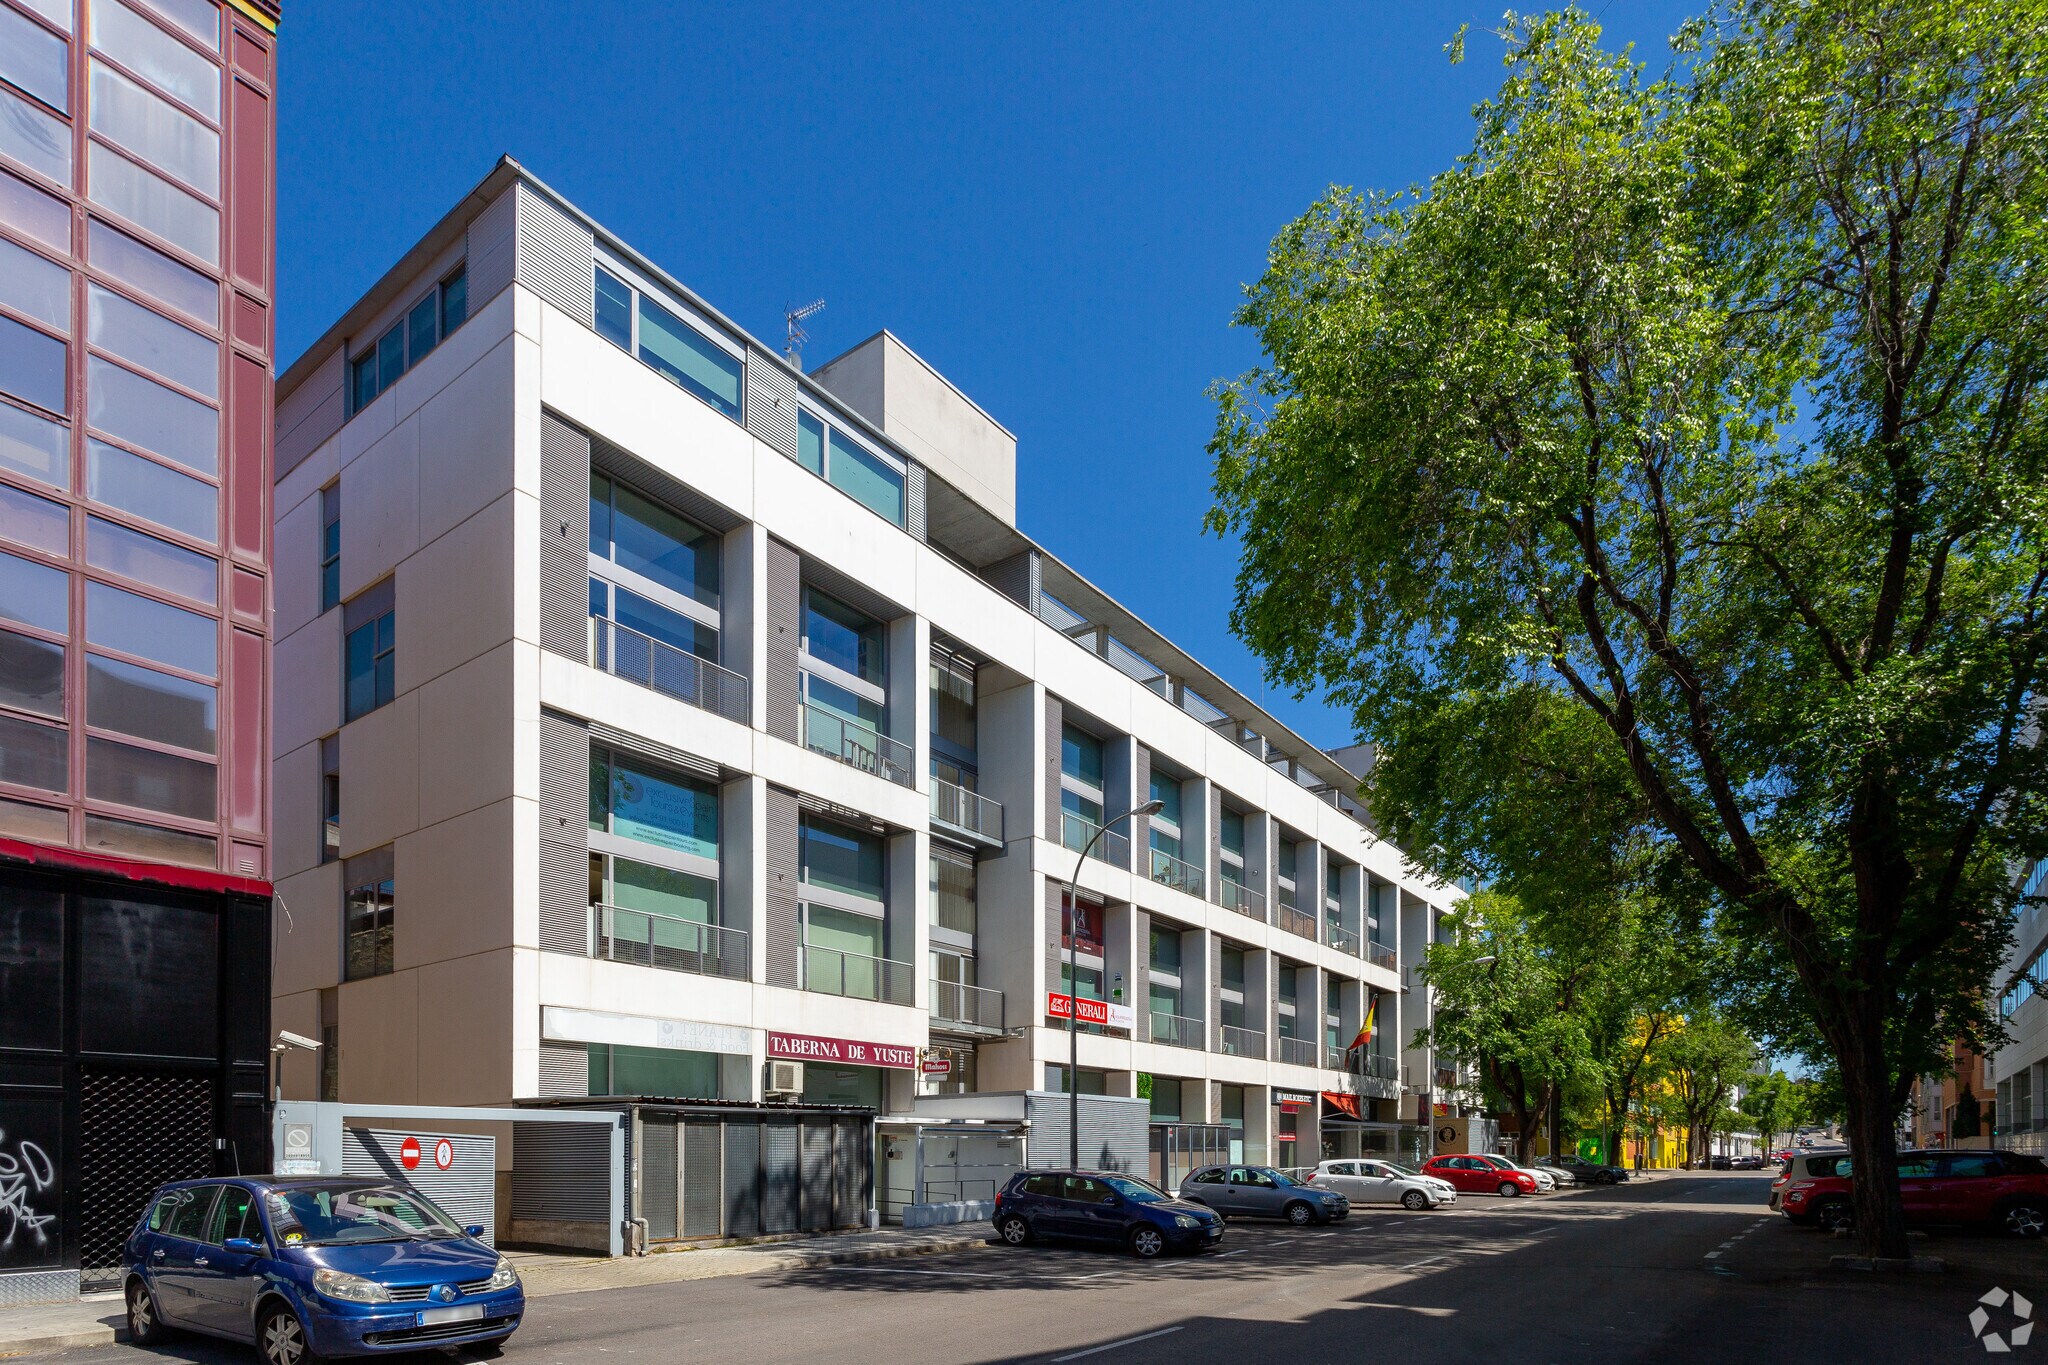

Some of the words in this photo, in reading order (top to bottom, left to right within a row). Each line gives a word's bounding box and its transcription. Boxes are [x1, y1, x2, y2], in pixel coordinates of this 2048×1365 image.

[1064, 1000, 1106, 1020] GNERALI
[771, 1037, 841, 1058] TABERNA
[848, 1044, 866, 1060] DE
[873, 1047, 913, 1064] YUSTE
[925, 1063, 948, 1071] Mahou
